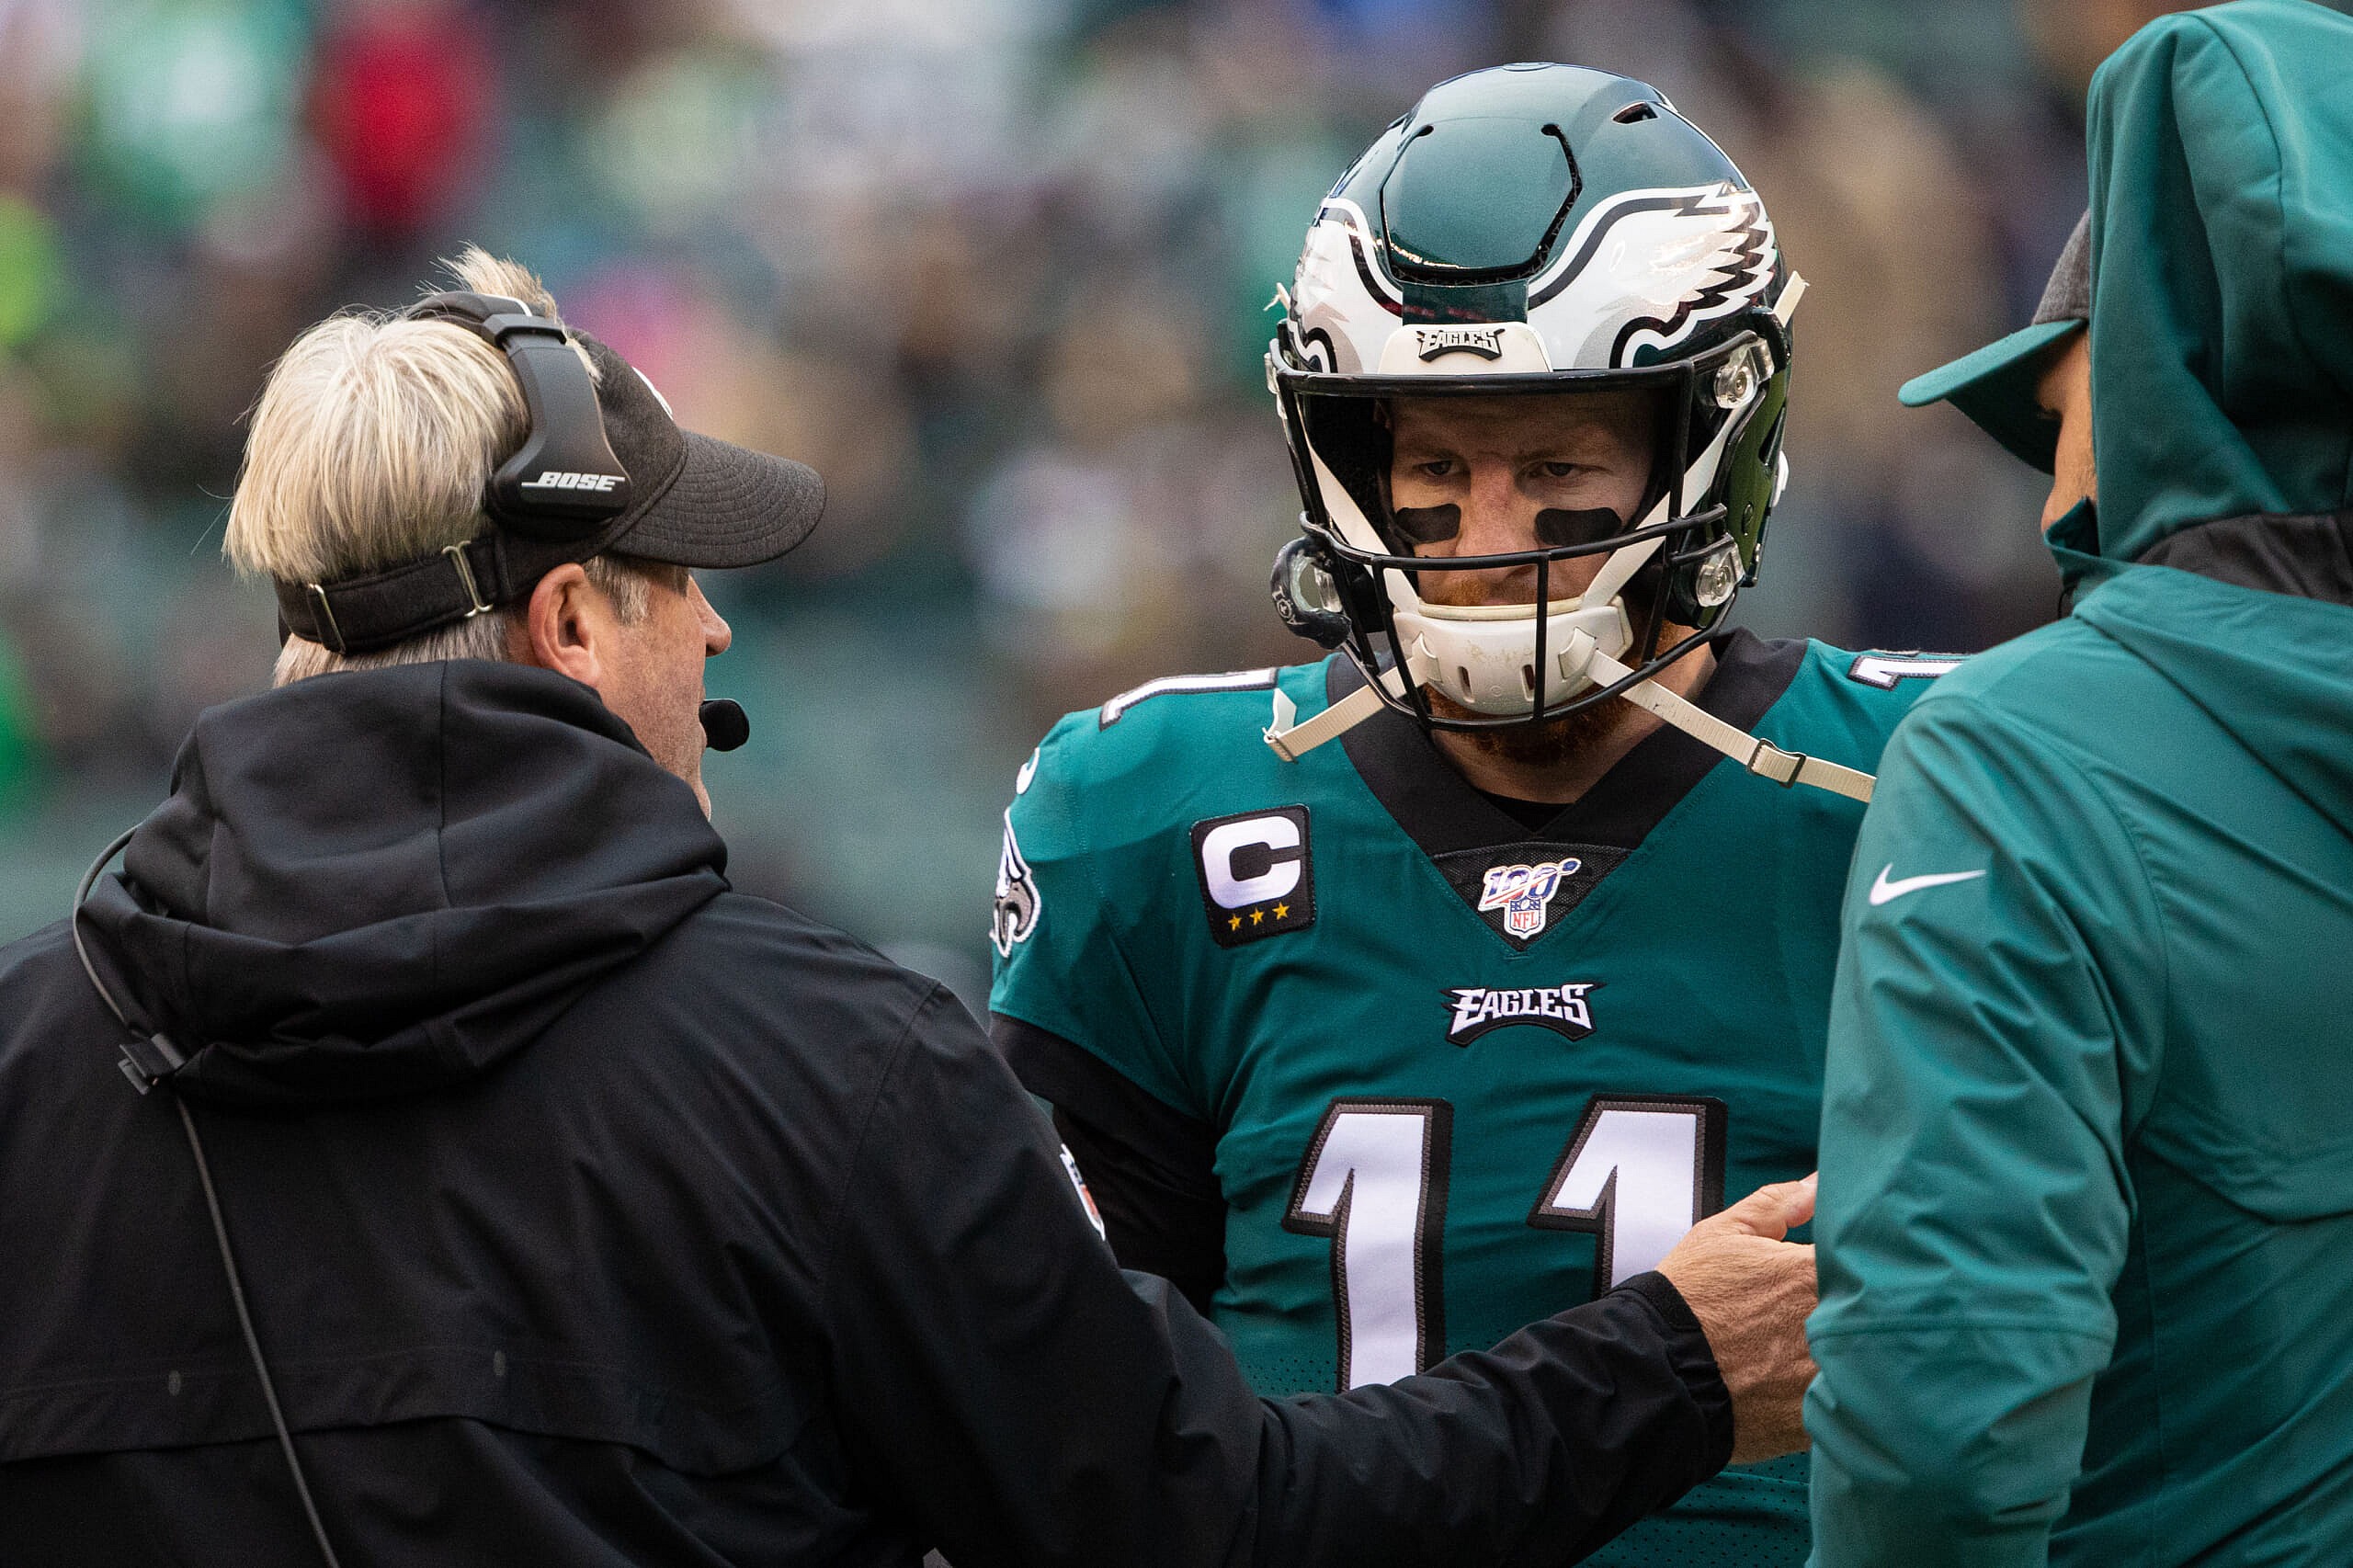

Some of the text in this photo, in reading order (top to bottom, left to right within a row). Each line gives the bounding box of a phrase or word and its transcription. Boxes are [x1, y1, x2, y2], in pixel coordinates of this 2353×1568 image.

[1418, 329, 1503, 358] EAGLES
[521, 472, 625, 491] BOSE
[1202, 816, 1302, 909] C
[1512, 911, 1538, 929] NFL
[1450, 983, 1595, 1035] EAGLES
[1283, 1096, 1728, 1392] 11
